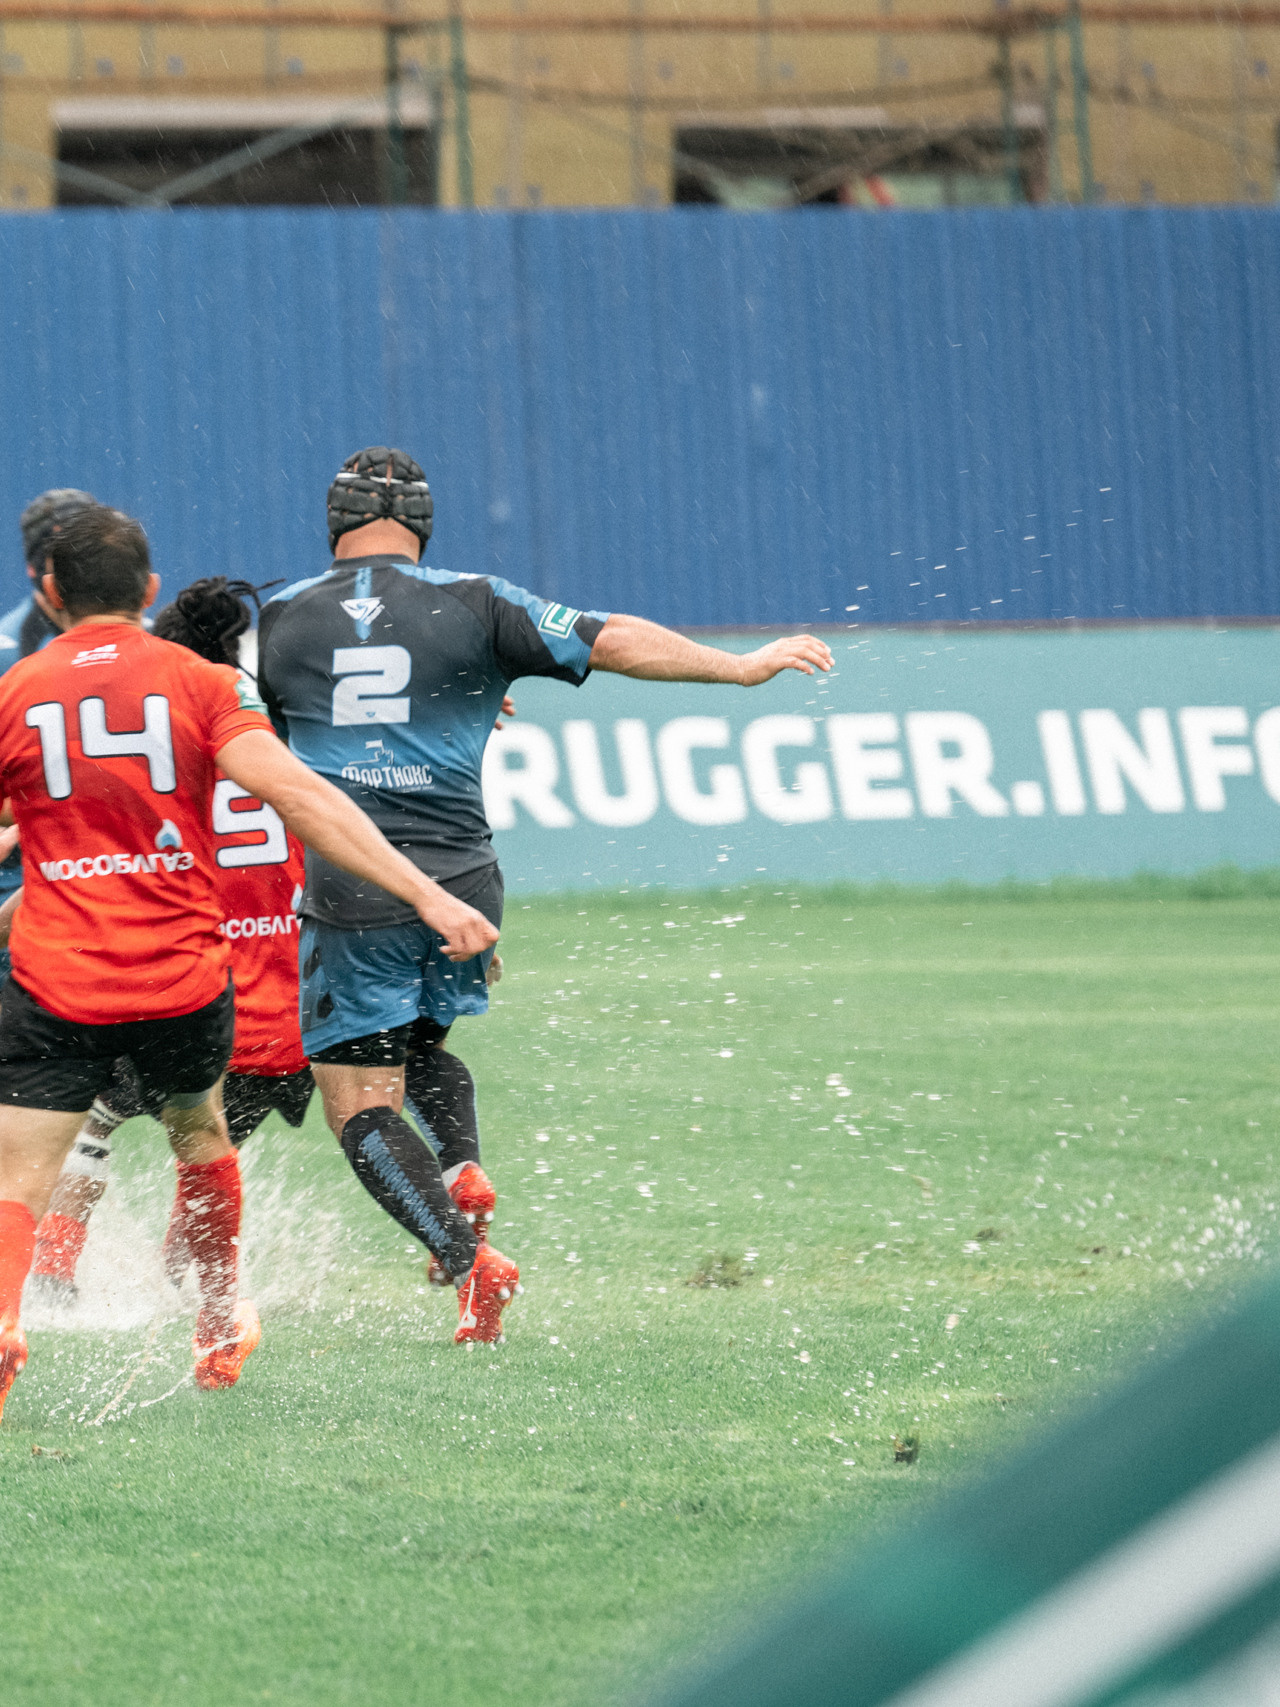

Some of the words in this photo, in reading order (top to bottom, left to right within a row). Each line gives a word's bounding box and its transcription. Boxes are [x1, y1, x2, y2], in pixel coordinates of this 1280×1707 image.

[332, 645, 412, 727] 2
[25, 695, 177, 800] 14
[481, 704, 1280, 829] RUGGER.INF
